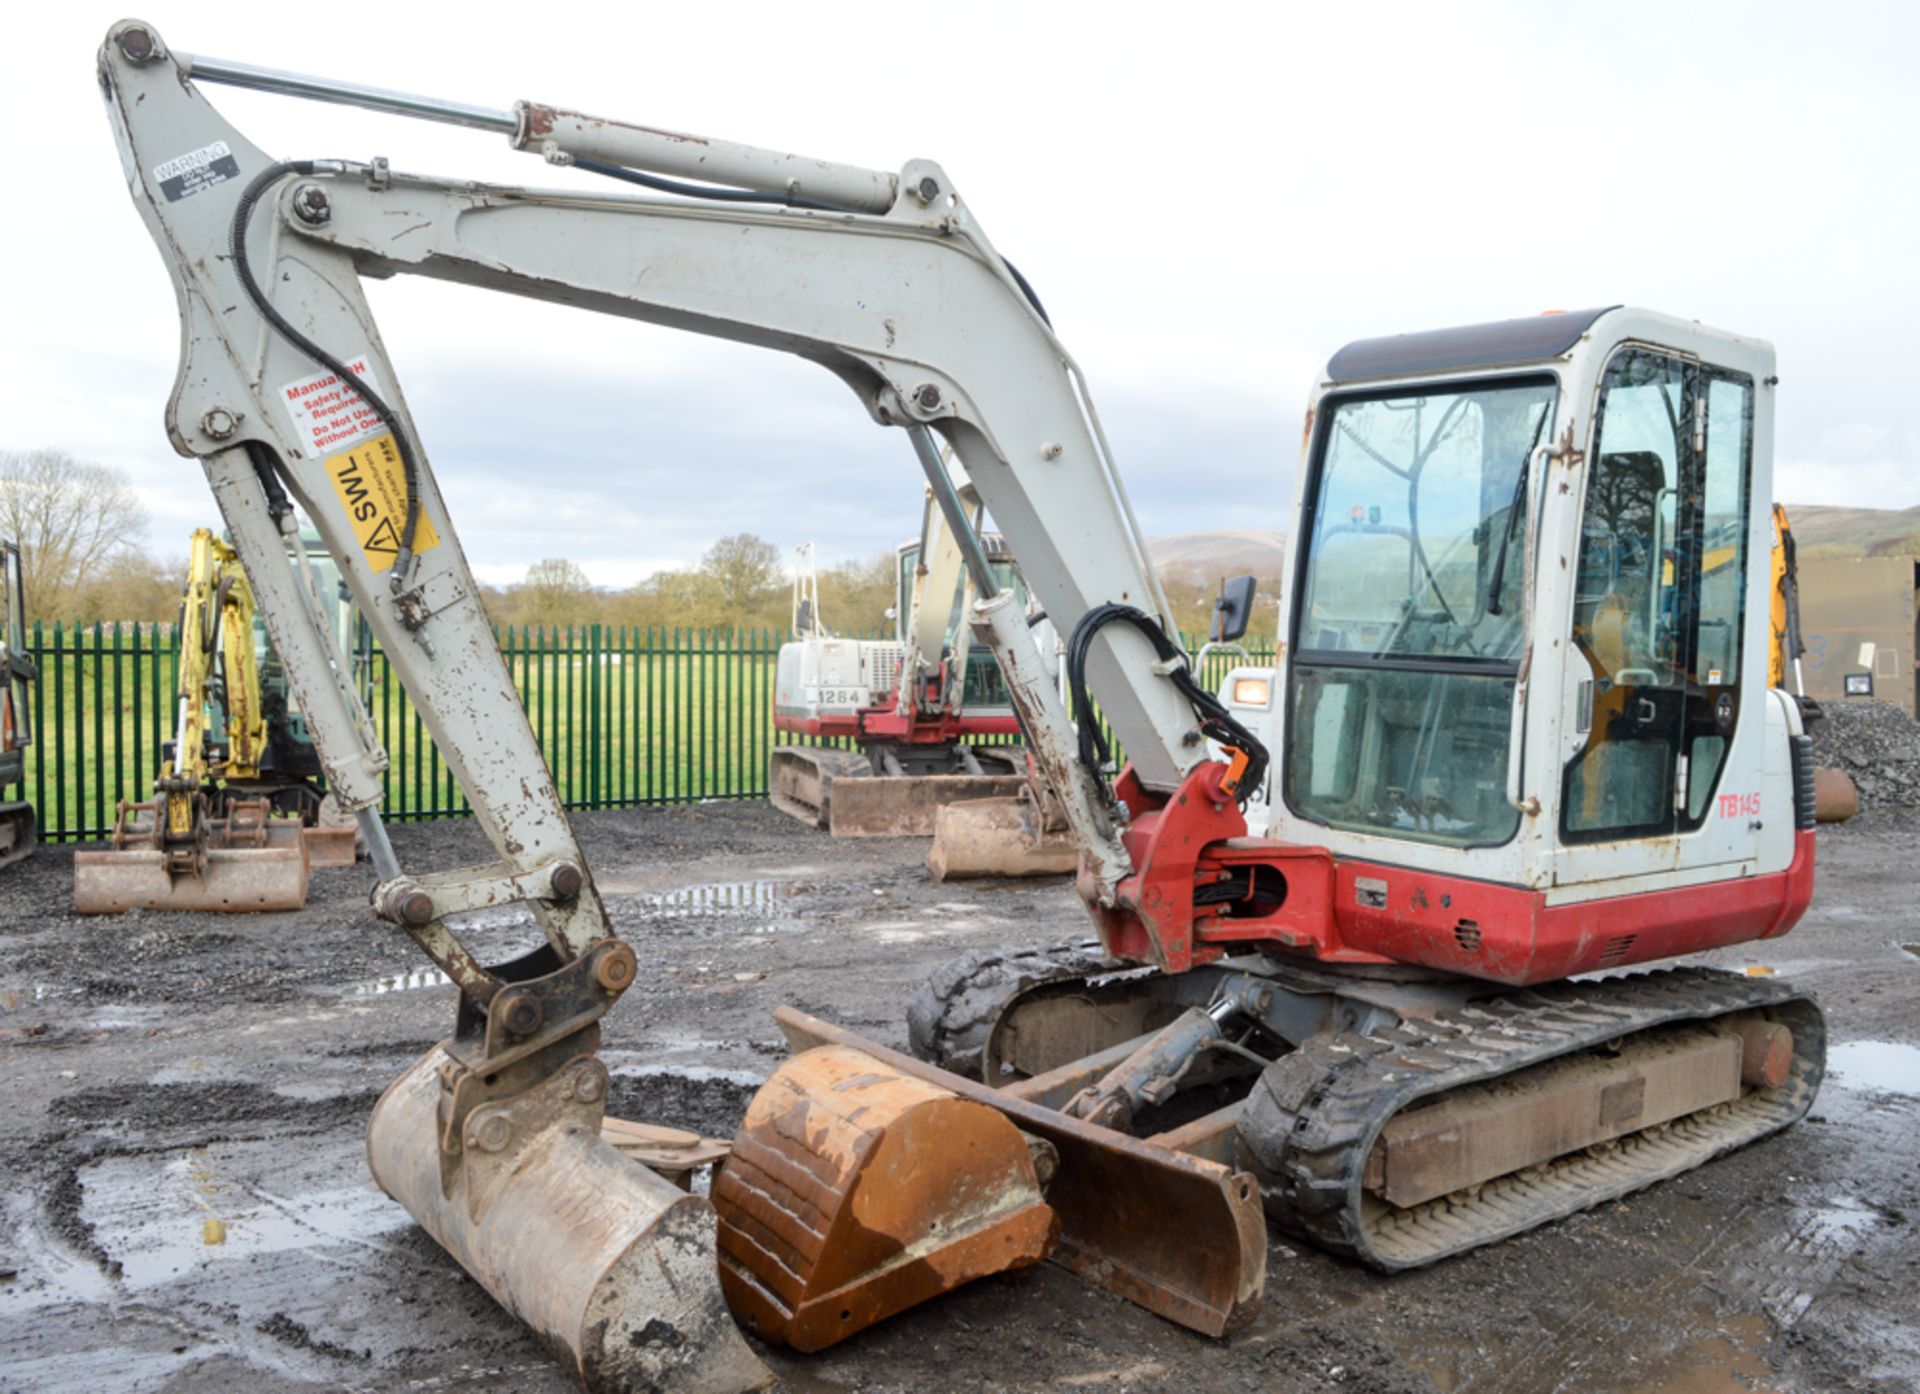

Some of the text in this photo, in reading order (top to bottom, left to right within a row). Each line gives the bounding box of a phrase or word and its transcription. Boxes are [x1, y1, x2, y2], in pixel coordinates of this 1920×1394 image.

[155, 143, 226, 178] WARNING
[303, 391, 341, 409] Safety
[312, 426, 329, 436] Do
[330, 415, 352, 428] Not
[313, 425, 358, 448] Without
[337, 456, 377, 522] SWL
[1718, 790, 1761, 819] TB145
